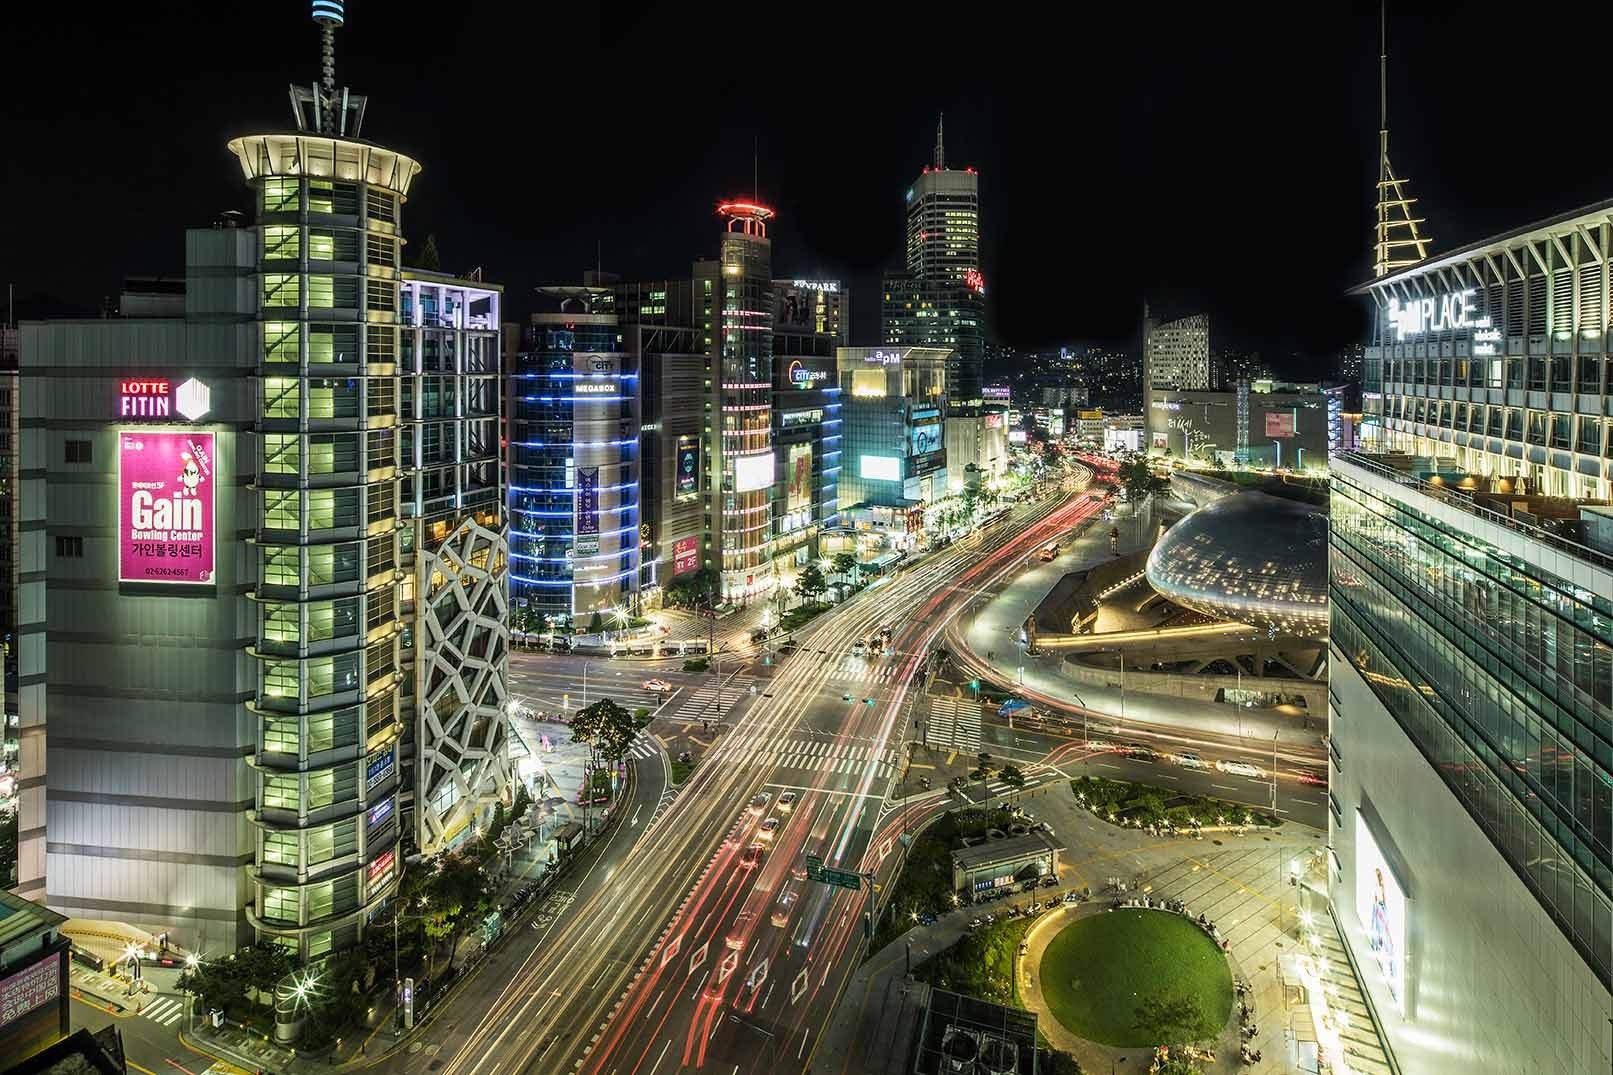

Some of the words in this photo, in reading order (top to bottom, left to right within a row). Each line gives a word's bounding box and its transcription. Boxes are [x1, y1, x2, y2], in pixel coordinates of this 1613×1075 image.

[1422, 289, 1475, 331] PLACE
[876, 351, 899, 365] apM
[796, 371, 809, 380] CITY
[122, 382, 168, 394] LOTTE
[575, 384, 615, 392] MEGABOX
[122, 396, 168, 416] FITIN
[132, 490, 202, 530] Gain
[132, 529, 168, 541] Bowling
[170, 529, 203, 541] Center
[132, 543, 203, 558] 가인볼링센터
